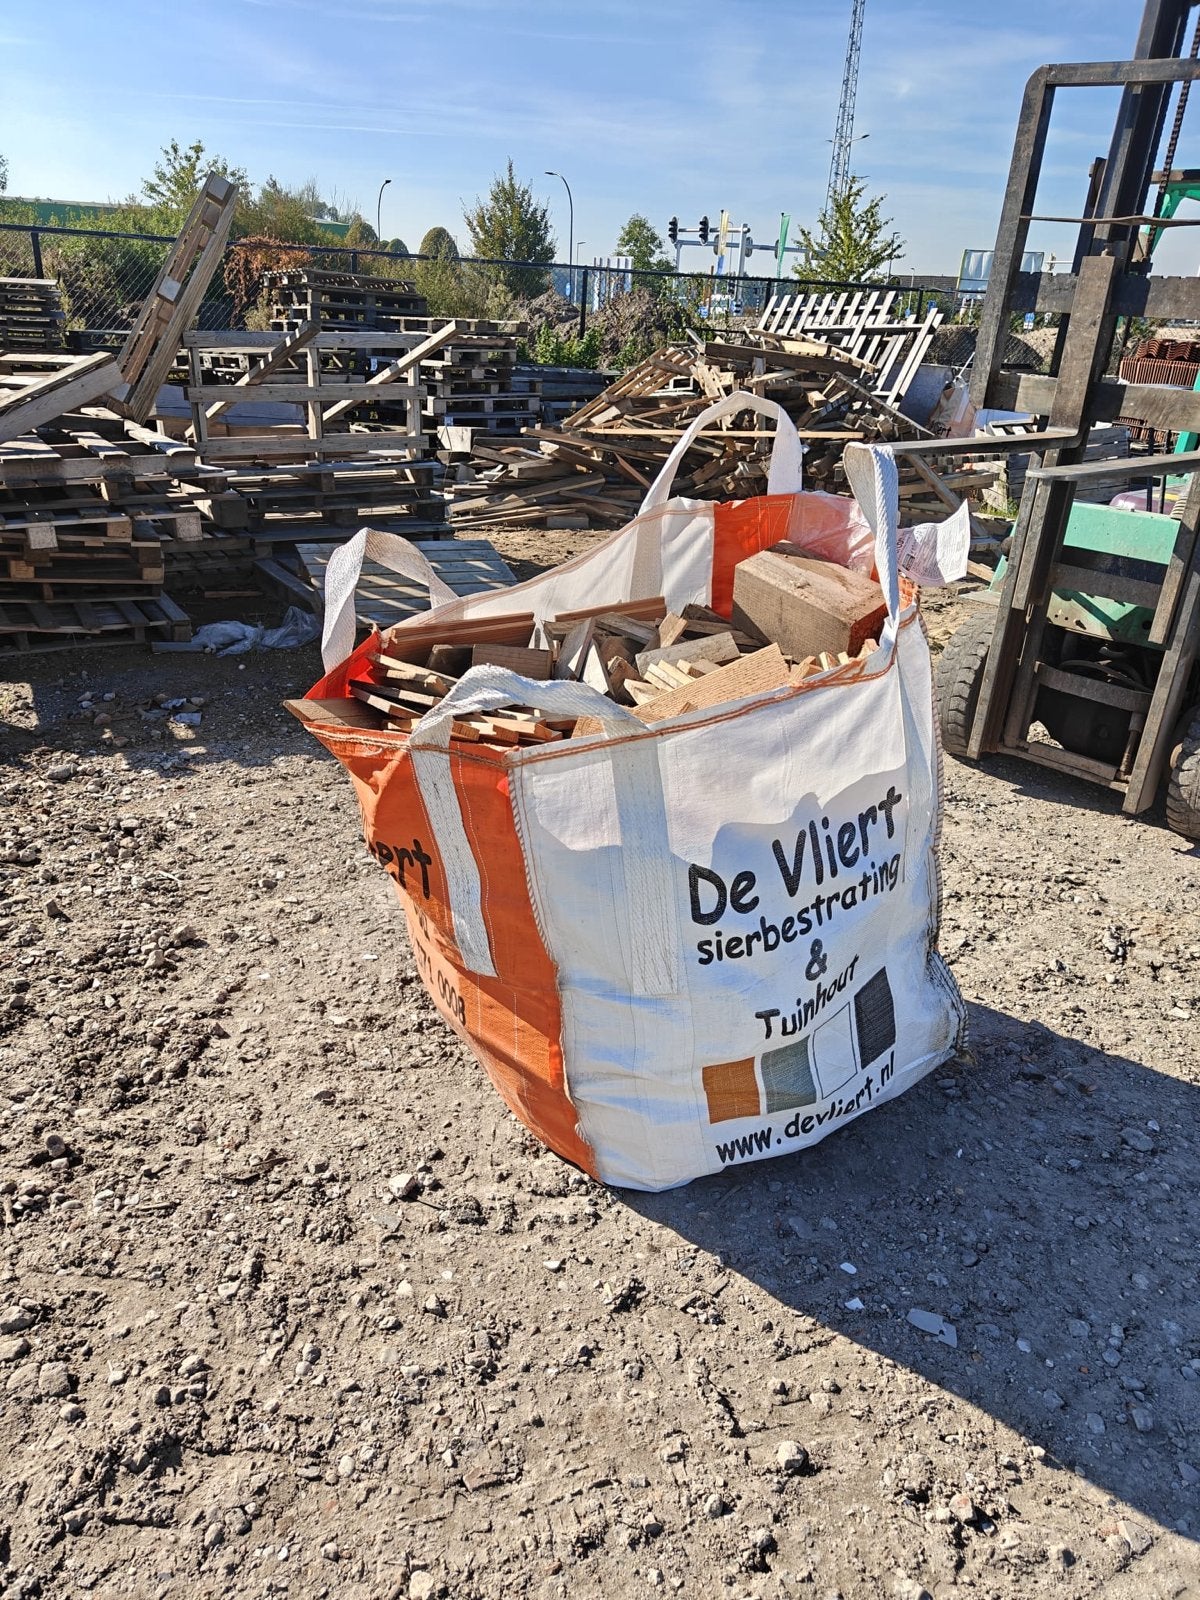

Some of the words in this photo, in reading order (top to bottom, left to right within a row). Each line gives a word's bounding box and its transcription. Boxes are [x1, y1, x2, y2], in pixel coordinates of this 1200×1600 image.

[688, 863, 760, 926] De
[772, 785, 903, 898] Vliert
[697, 853, 901, 966] sierbestrating
[755, 954, 860, 1040] Tuinhout
[805, 938, 828, 981] &
[715, 1050, 895, 1164] www.devliert.nl
